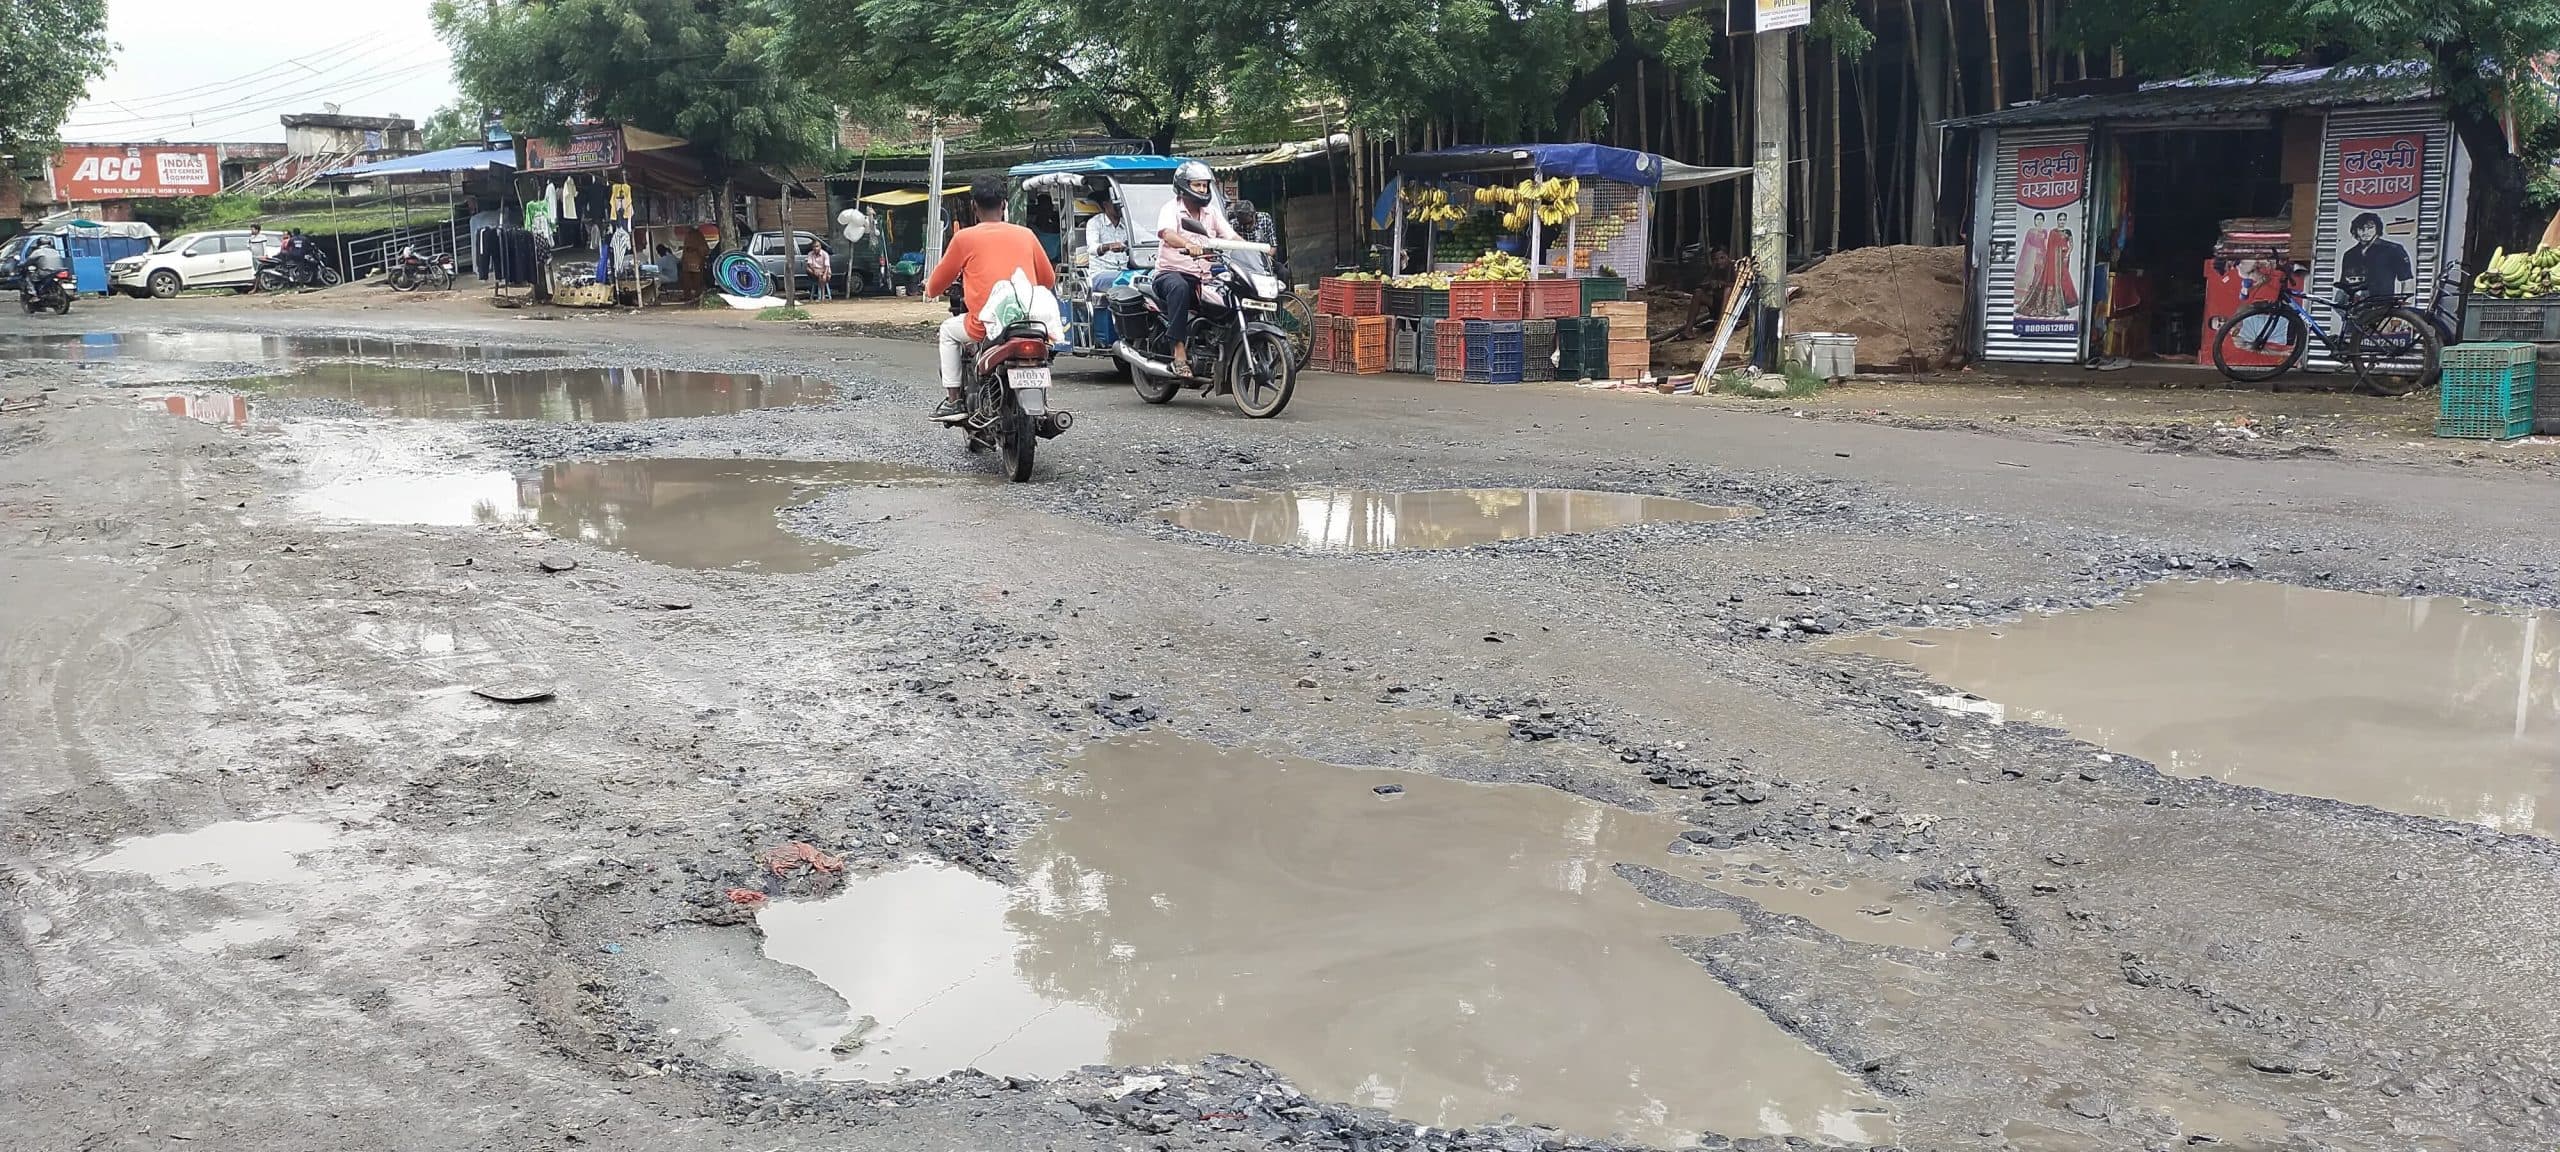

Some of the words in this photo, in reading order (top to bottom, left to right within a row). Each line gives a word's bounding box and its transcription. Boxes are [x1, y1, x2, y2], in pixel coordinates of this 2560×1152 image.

[2021, 149, 2080, 178] लक्ष्मी
[2343, 139, 2418, 174] लक्ष्मी
[72, 157, 142, 181] ACC
[2021, 179, 2078, 198] वस्त्रालय
[2343, 175, 2415, 195] वस्त्रालय
